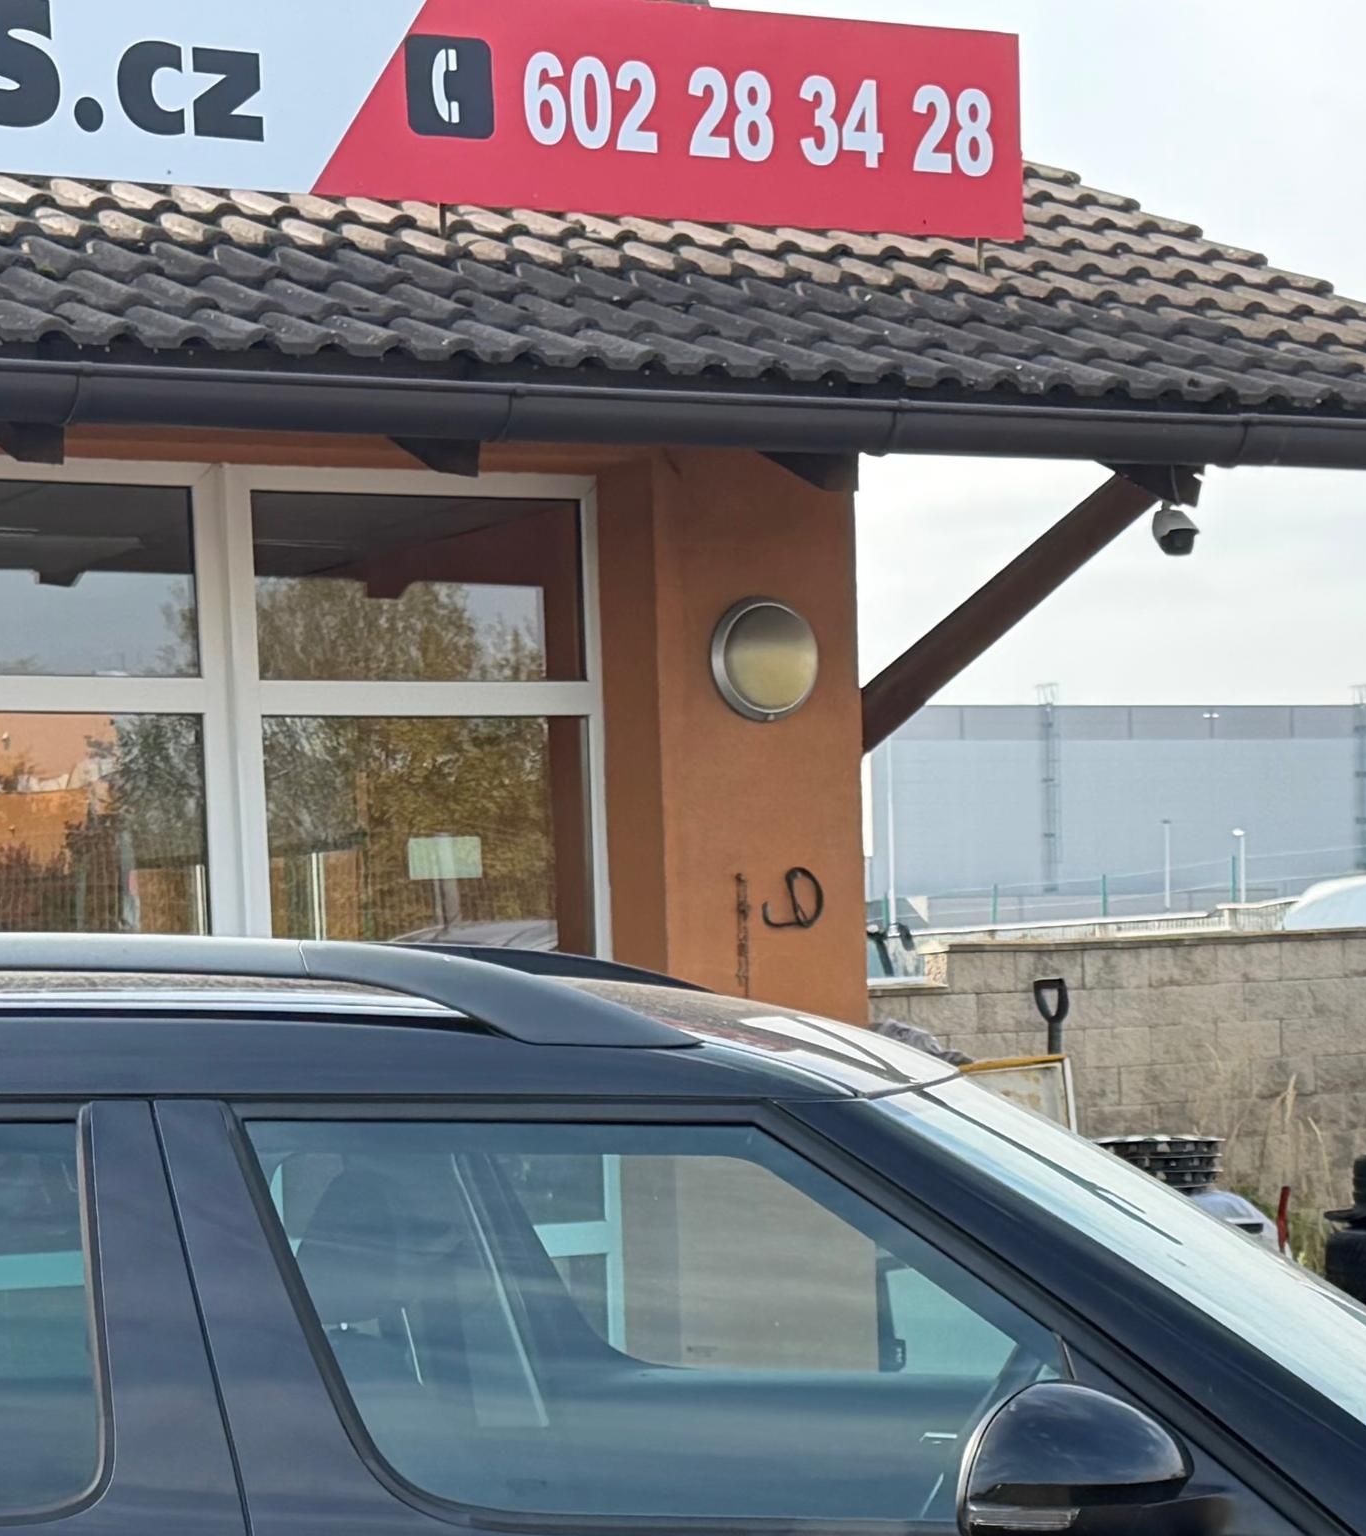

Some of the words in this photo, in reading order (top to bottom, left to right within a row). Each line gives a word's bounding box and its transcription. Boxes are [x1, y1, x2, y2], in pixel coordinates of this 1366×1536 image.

[524, 51, 658, 153] 602
[688, 66, 774, 162] 28
[799, 75, 883, 168] 34
[912, 84, 994, 176] 28
